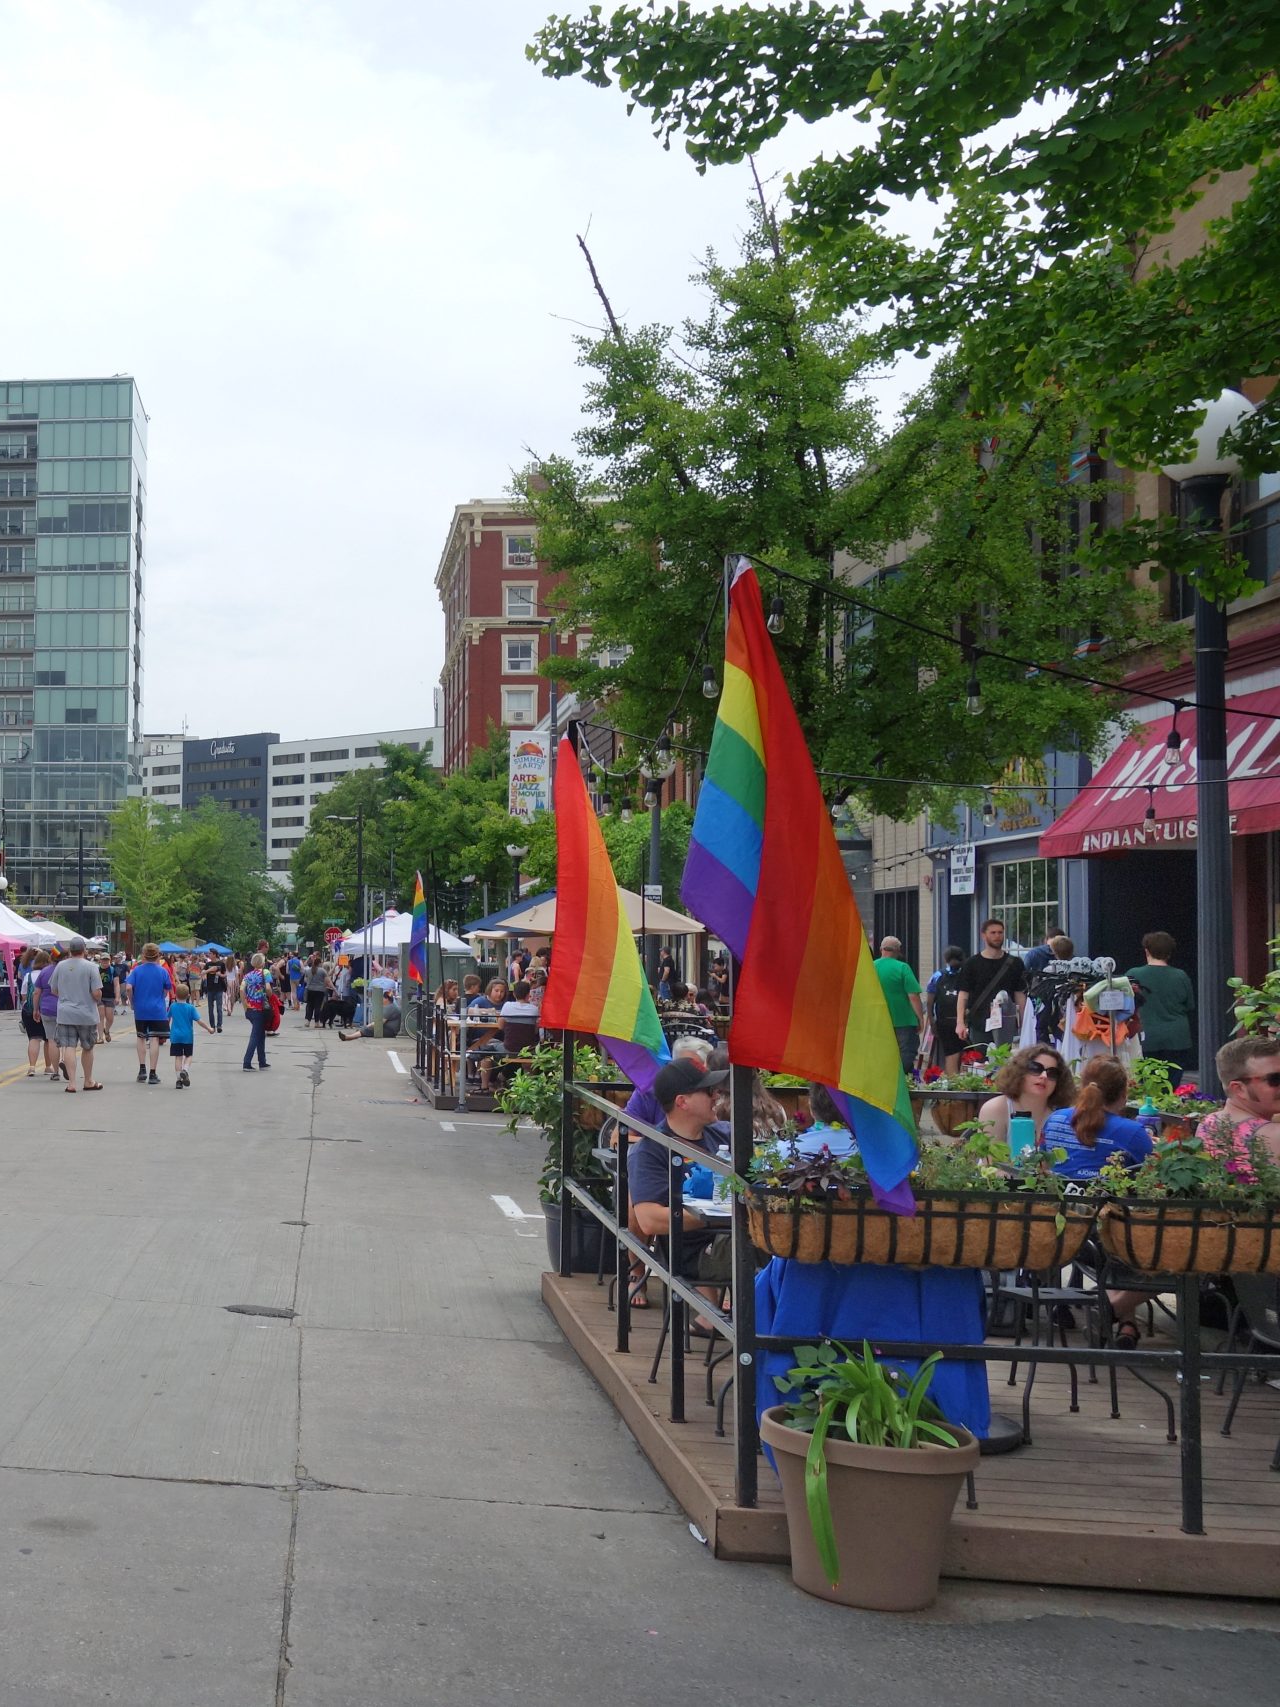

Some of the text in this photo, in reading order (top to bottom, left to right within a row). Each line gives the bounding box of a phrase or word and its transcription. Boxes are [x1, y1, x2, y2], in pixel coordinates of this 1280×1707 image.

[210, 740, 236, 760] Graduate
[513, 756, 545, 766] SUMMER
[1094, 718, 1280, 806] MASAL
[512, 773, 537, 782] ARTS
[517, 782, 540, 791] JAZZ
[510, 808, 528, 816] FUN
[1082, 815, 1238, 852] INDIAN CUISE
[325, 932, 342, 940] STOP
